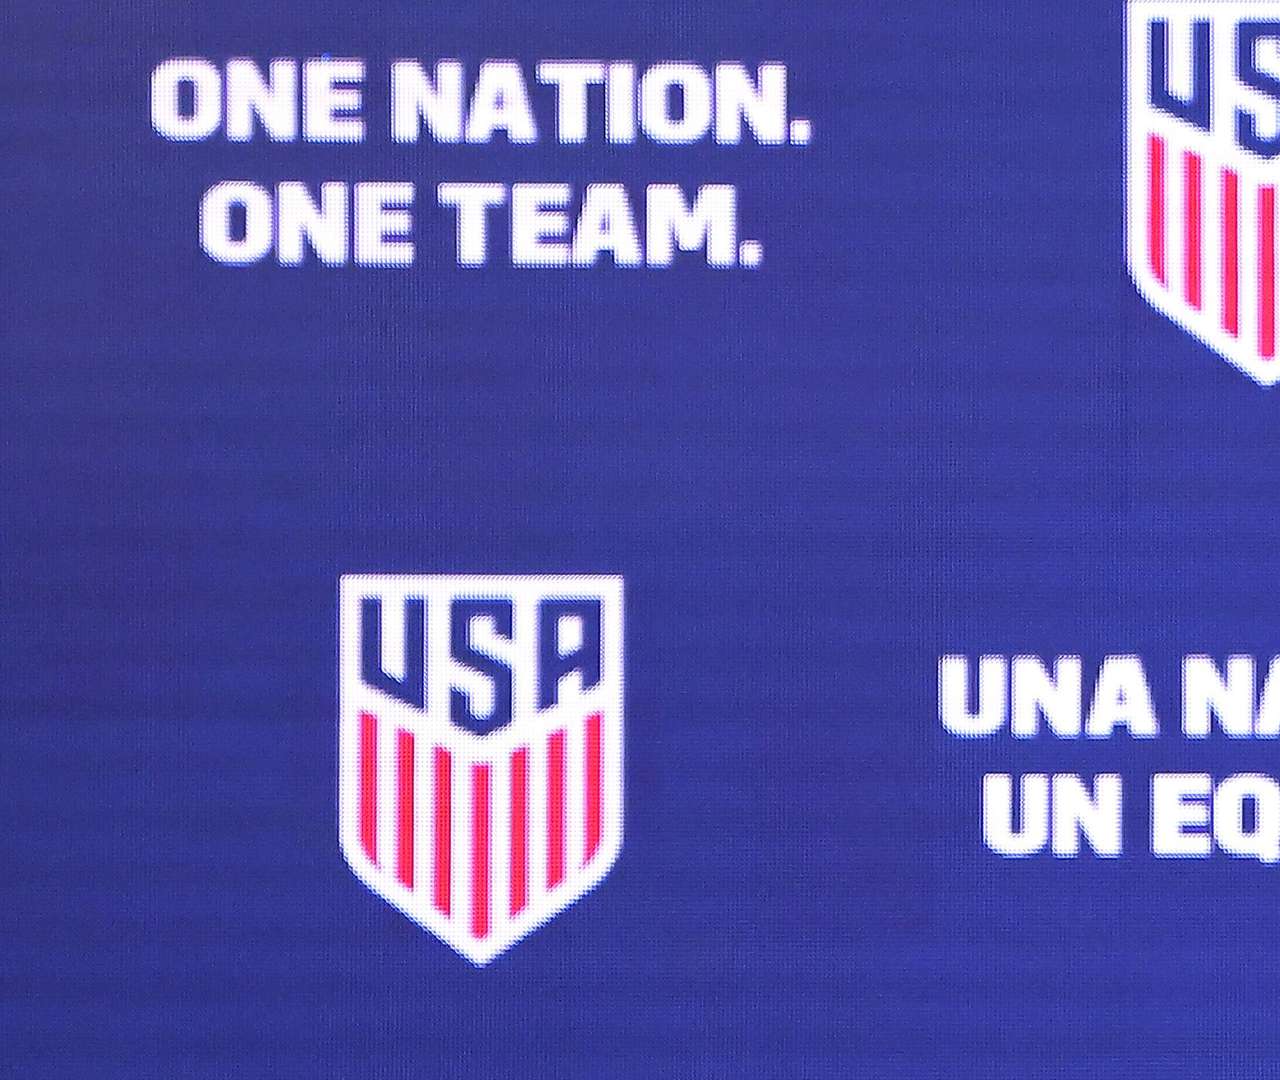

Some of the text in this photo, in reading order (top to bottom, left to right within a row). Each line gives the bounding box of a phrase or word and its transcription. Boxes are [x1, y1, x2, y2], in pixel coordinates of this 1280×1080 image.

[151, 57, 811, 145] ONE NATION.
[199, 181, 762, 269] ONE TEAM.
[360, 595, 603, 735] USA
[938, 654, 1160, 740] UNA
[982, 773, 1123, 859] UN
